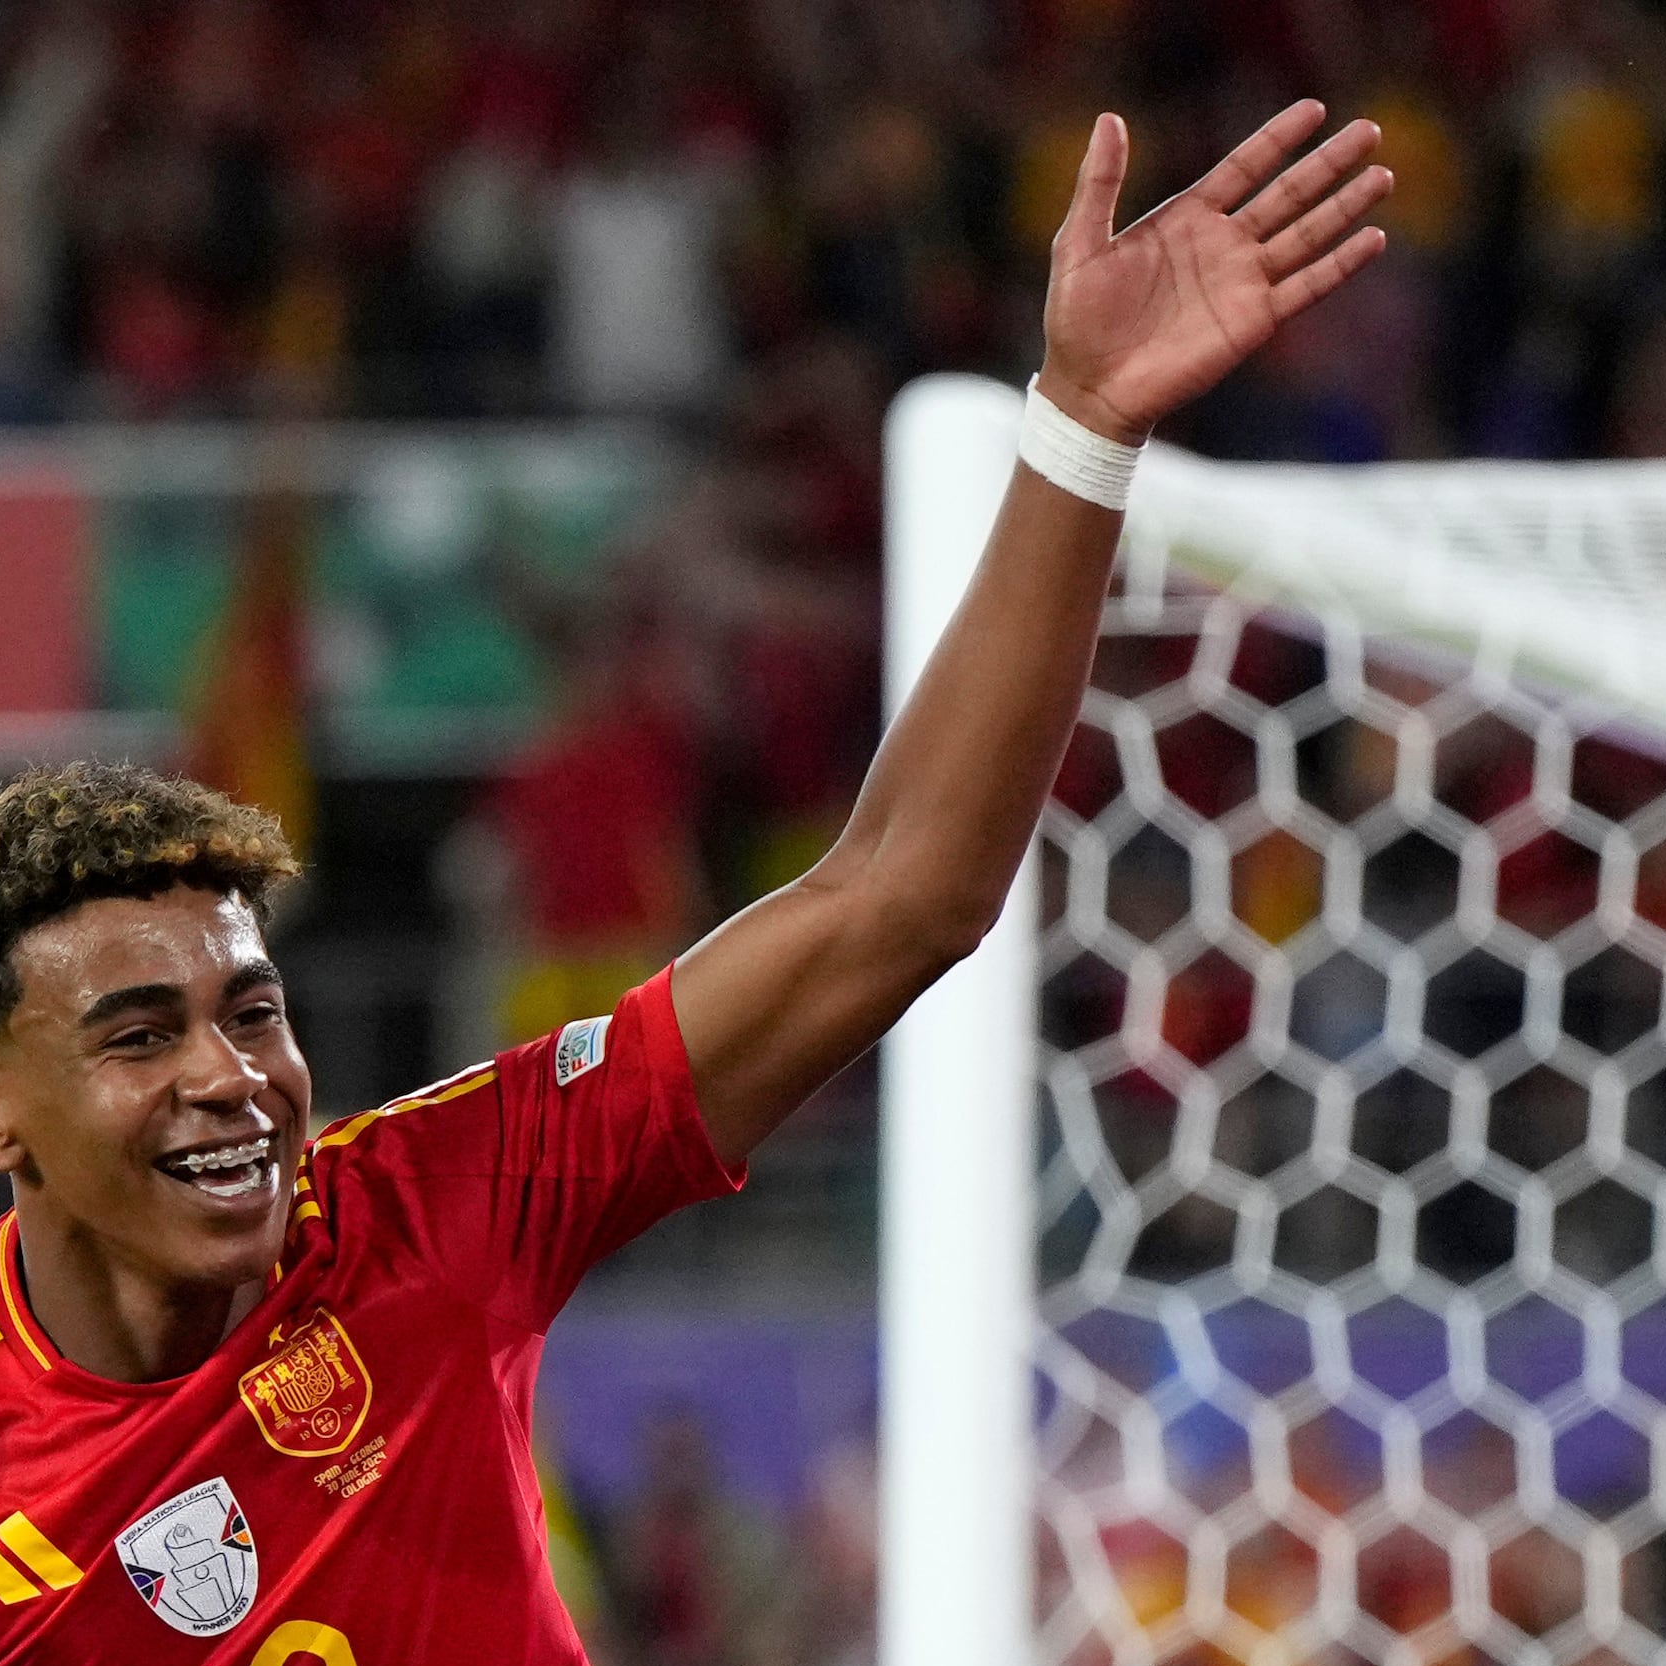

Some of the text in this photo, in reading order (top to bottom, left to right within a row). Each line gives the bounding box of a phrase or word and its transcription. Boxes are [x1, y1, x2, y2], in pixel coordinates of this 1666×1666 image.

[313, 1464, 342, 1488] SPAIN
[349, 1435, 387, 1466] GEORGIA
[325, 1450, 388, 1495] 30 JUNE 2024
[340, 1468, 382, 1499] COLOGNE
[143, 1499, 183, 1528] NATIONS
[183, 1482, 221, 1503] LEAGUE
[193, 1615, 232, 1631] WINNER
